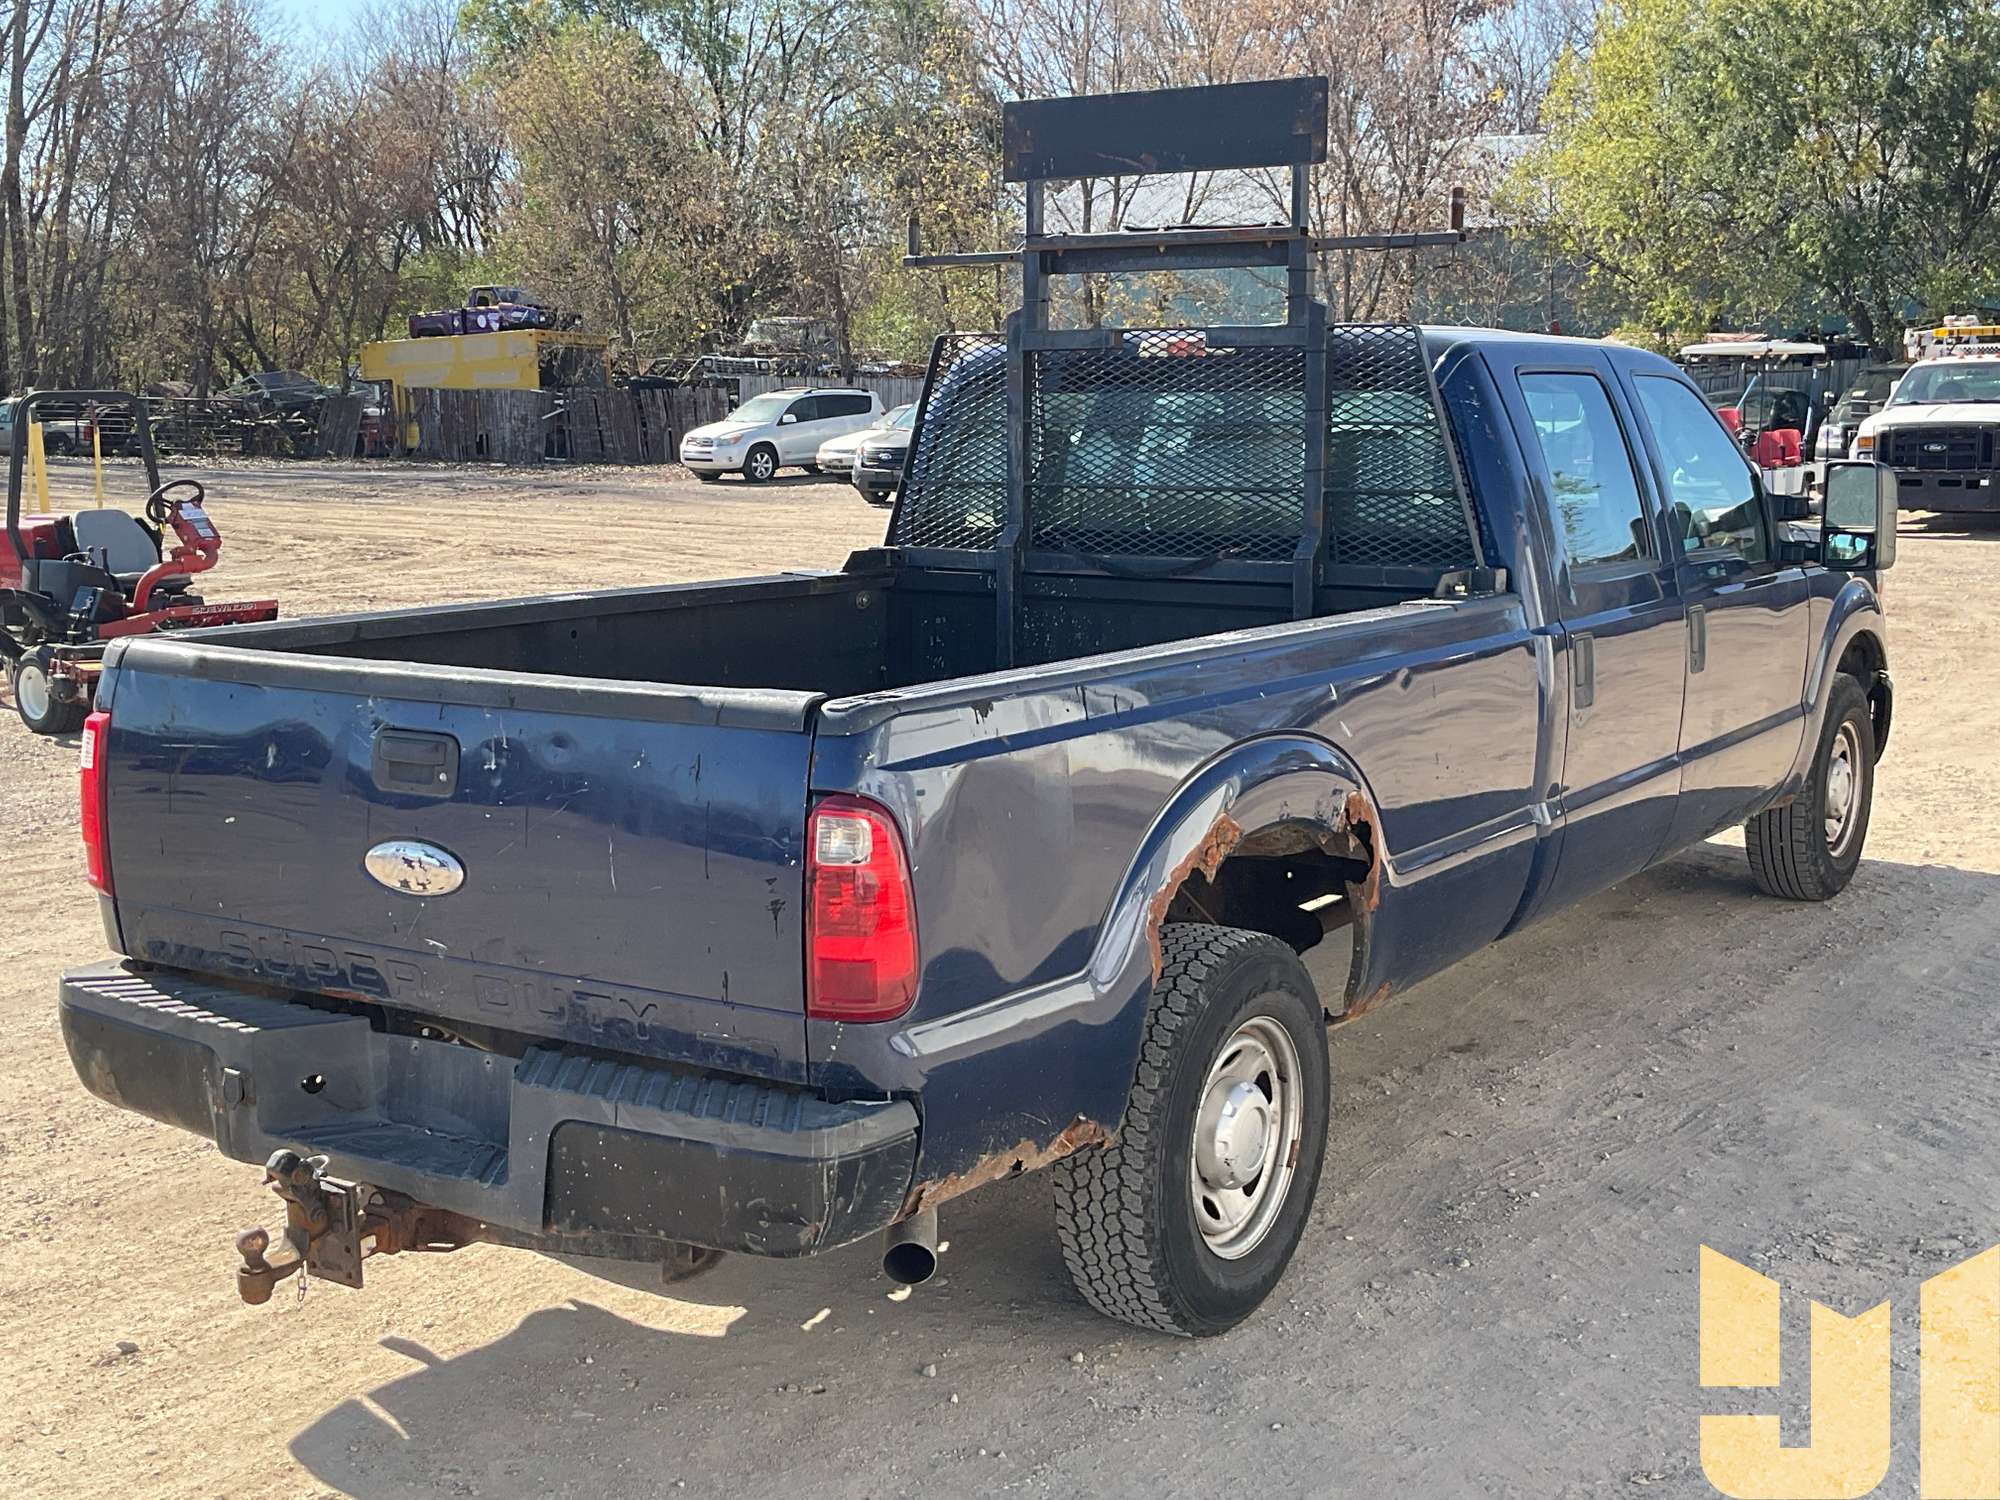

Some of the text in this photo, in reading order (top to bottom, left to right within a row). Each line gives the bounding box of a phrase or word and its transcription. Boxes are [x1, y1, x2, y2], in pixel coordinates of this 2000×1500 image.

[192, 603, 257, 615] SIDEWI
[220, 930, 658, 1040] SUPER DUTY
